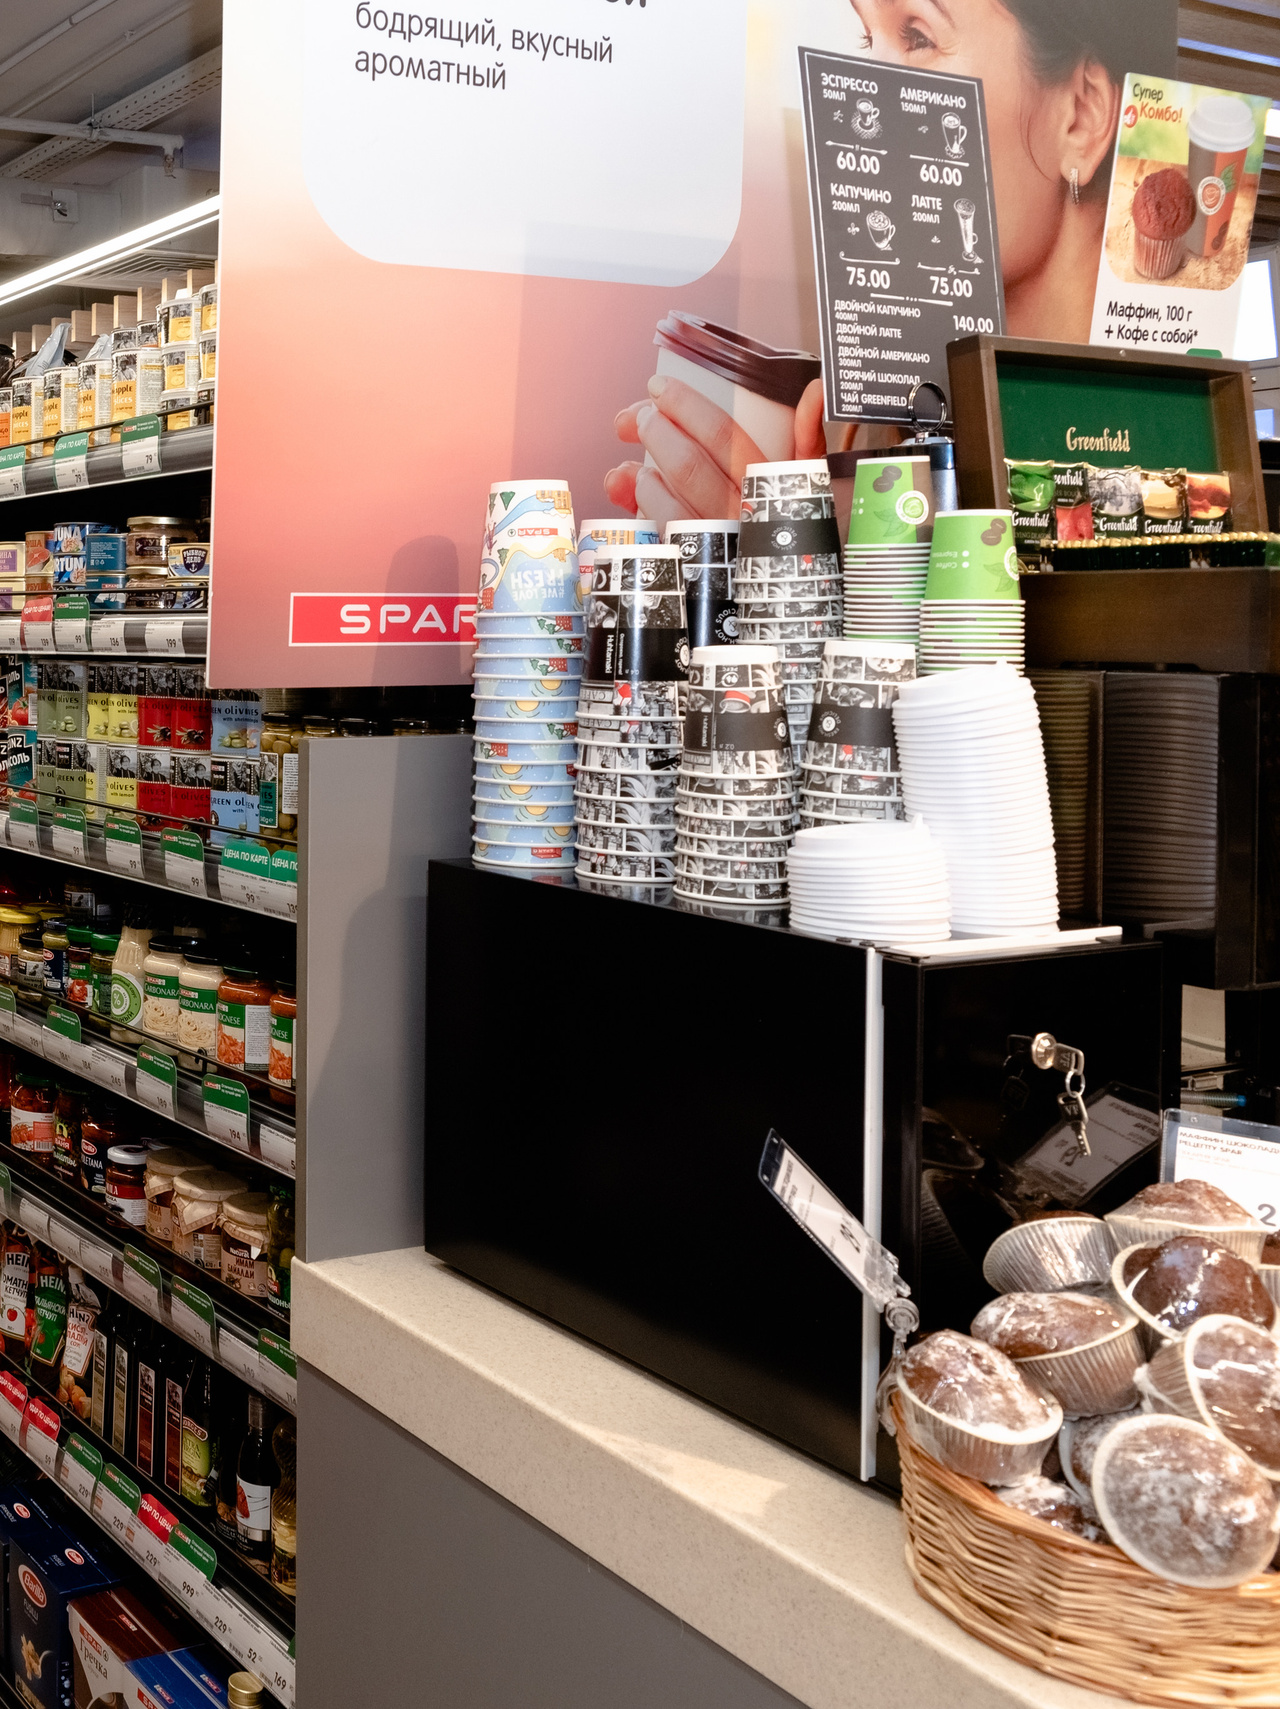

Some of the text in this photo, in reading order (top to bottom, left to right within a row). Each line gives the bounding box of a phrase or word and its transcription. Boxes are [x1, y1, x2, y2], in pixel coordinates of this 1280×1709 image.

[355, 2, 614, 63] бодрящий, вкусный
[355, 47, 507, 90] ароматный
[821, 73, 878, 94] ЭСПРЕССО
[823, 89, 846, 101] 50МЛ
[900, 87, 966, 109] АМЕРИКАНО
[1133, 83, 1163, 102] Супер
[901, 102, 926, 114] 150МЛ
[1139, 101, 1182, 124] Комбо!
[837, 151, 880, 175] 60.00
[920, 164, 962, 186] 60.00
[831, 183, 891, 203] КАПУЧИНО
[832, 201, 860, 213] 200МЛ
[911, 195, 942, 210] ЛАТТЕ
[913, 212, 940, 224] 200МЛ
[846, 267, 890, 289] 75.00
[930, 276, 972, 297] 75.00
[834, 300, 920, 318] ДВОЙНОЙ КАПУЧИНО
[1106, 301, 1193, 323] Маффин, 100 г
[836, 323, 902, 339] ДВОЙНОЙ ЛАТТЕ
[953, 315, 993, 333] 140.00
[1116, 324, 1149, 344] Кофе
[1152, 330, 1158, 342] с
[838, 346, 930, 364] ДВОЙНОЙ АМЕРИКАНО
[839, 370, 920, 385] ГОРЯЧИЙ ШОКОЛАД
[840, 392, 907, 407] ЧАЙ GREENFIELD
[1066, 427, 1131, 452] Greenfield
[146, 455, 153, 463] 79
[1054, 469, 1083, 486] eenfield
[1012, 512, 1049, 527] Greenfield
[1100, 516, 1138, 532] Greenfield
[1144, 519, 1182, 534] Greenfield
[518, 528, 551, 536] SPAR
[183, 550, 206, 558] РЫБНОЕ
[511, 568, 564, 589] FRESH
[512, 587, 565, 602] #WE LOVE
[340, 604, 477, 634] SPAR
[75, 635, 82, 643] 99
[110, 637, 119, 647] 136
[166, 639, 177, 648] 199
[605, 634, 615, 674] Huhtamaki
[73, 847, 80, 855] 99
[224, 848, 268, 865] ЦЕНА ПО КАРТЕ
[130, 860, 137, 869] 99
[272, 857, 289, 869] ЦЕНА
[191, 877, 200, 886] 99
[246, 893, 255, 903] 99
[229, 1129, 241, 1140] 194
[1179, 1131, 1224, 1144] МАФФИН
[1179, 1139, 1217, 1151] РЕЦЕПТУ
[1220, 1146, 1243, 1156] SPAR
[235, 1258, 255, 1269] ИМАМ
[46, 1454, 51, 1465] 59
[79, 1484, 89, 1498] 229
[140, 1498, 159, 1520] УДАР ПО
[113, 1516, 123, 1532] 229
[146, 1550, 157, 1567] 229
[24, 1572, 45, 1603] Barilla
[182, 1581, 195, 1597] 999
[214, 1616, 227, 1633] 229
[83, 1630, 102, 1654] SPAR
[80, 1638, 108, 1679] Гречка
[247, 1648, 257, 1664] 52
[274, 1671, 287, 1690] 169
